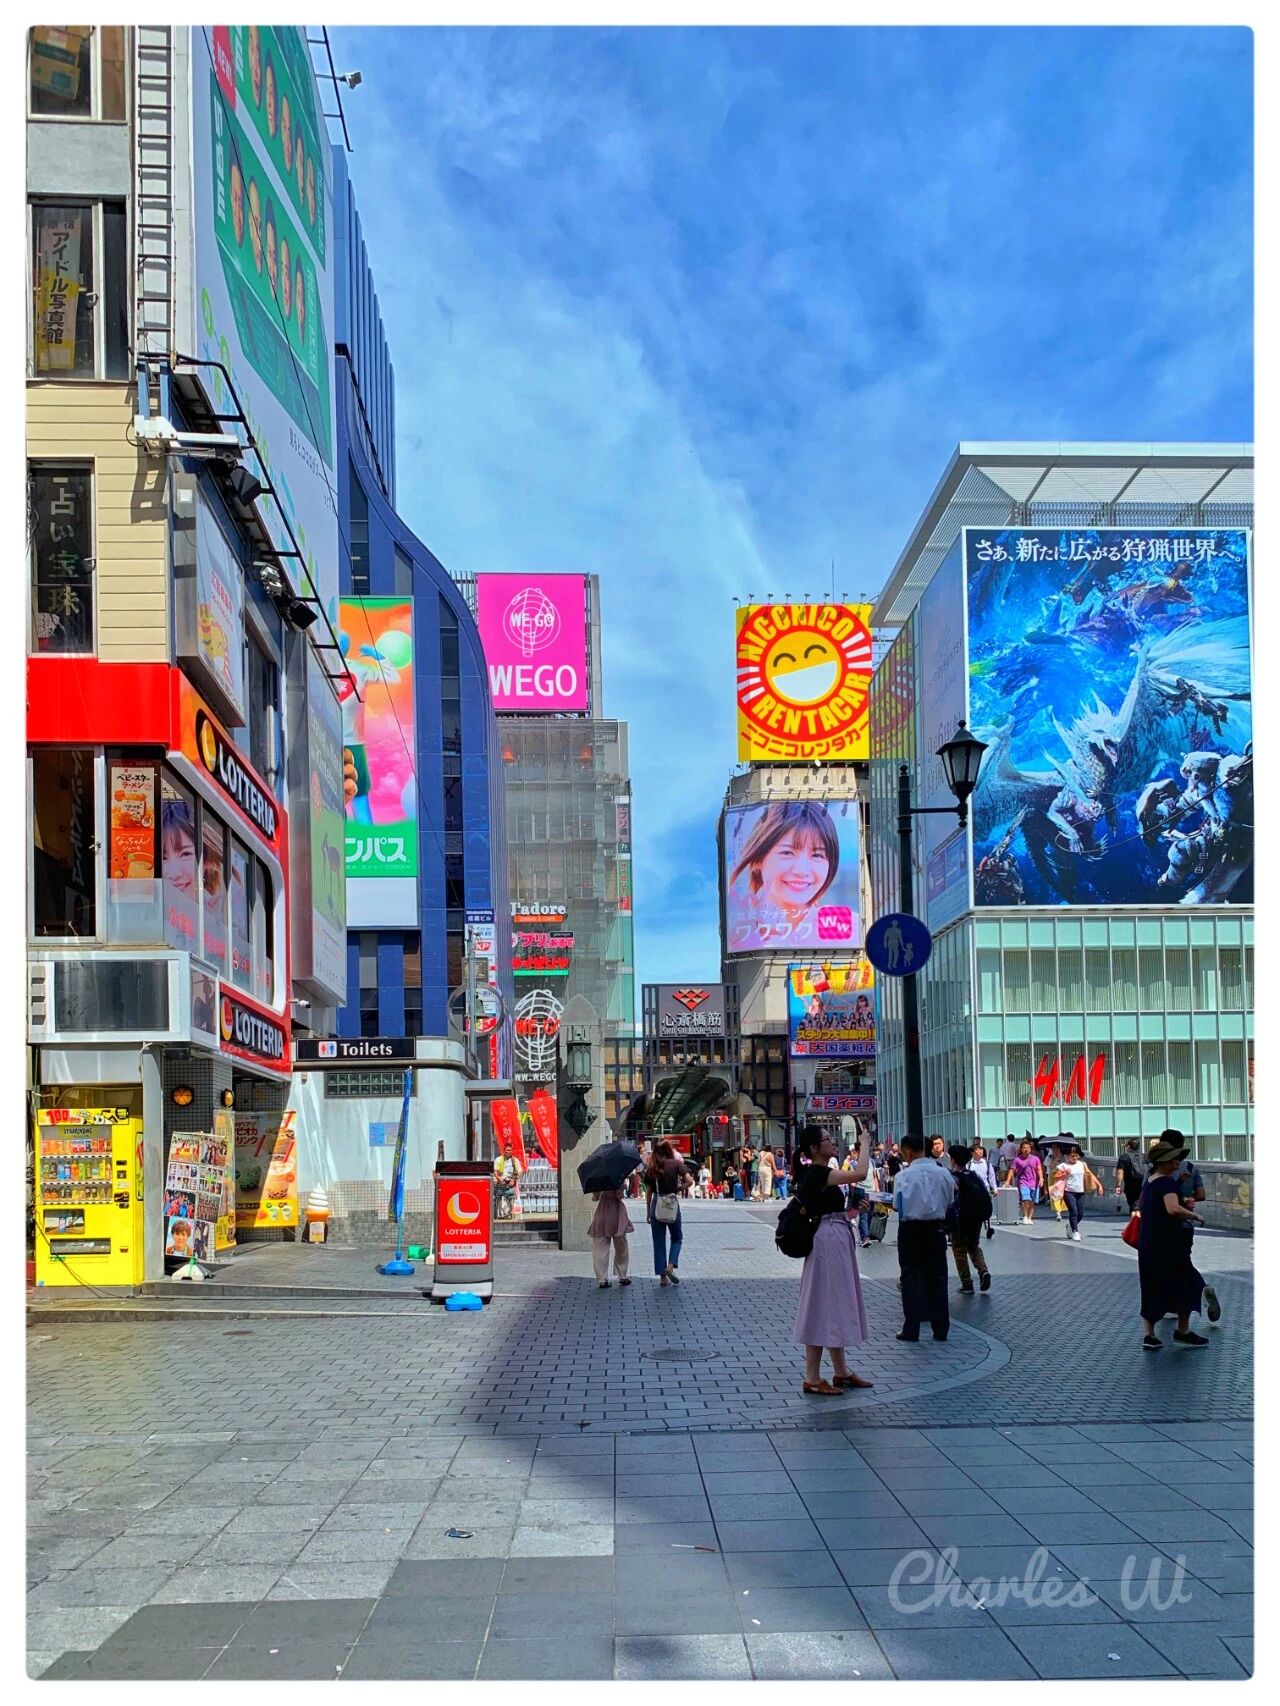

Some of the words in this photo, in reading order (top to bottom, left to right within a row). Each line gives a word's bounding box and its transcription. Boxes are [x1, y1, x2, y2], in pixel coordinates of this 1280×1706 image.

[975, 537, 1241, 563] さあ、新たに広がる狩猟世界へ。
[739, 604, 854, 660] NICONICO
[489, 664, 578, 697] WEGO
[751, 672, 871, 735] RENTACAR
[740, 720, 869, 758] ニコニコレンタカー
[219, 741, 276, 839] LOTTERIA
[235, 1008, 284, 1060] LOTTERIA
[661, 1011, 722, 1027] 心斎橋筋
[340, 1042, 393, 1056] Toilets
[1027, 1053, 1106, 1106] H&M
